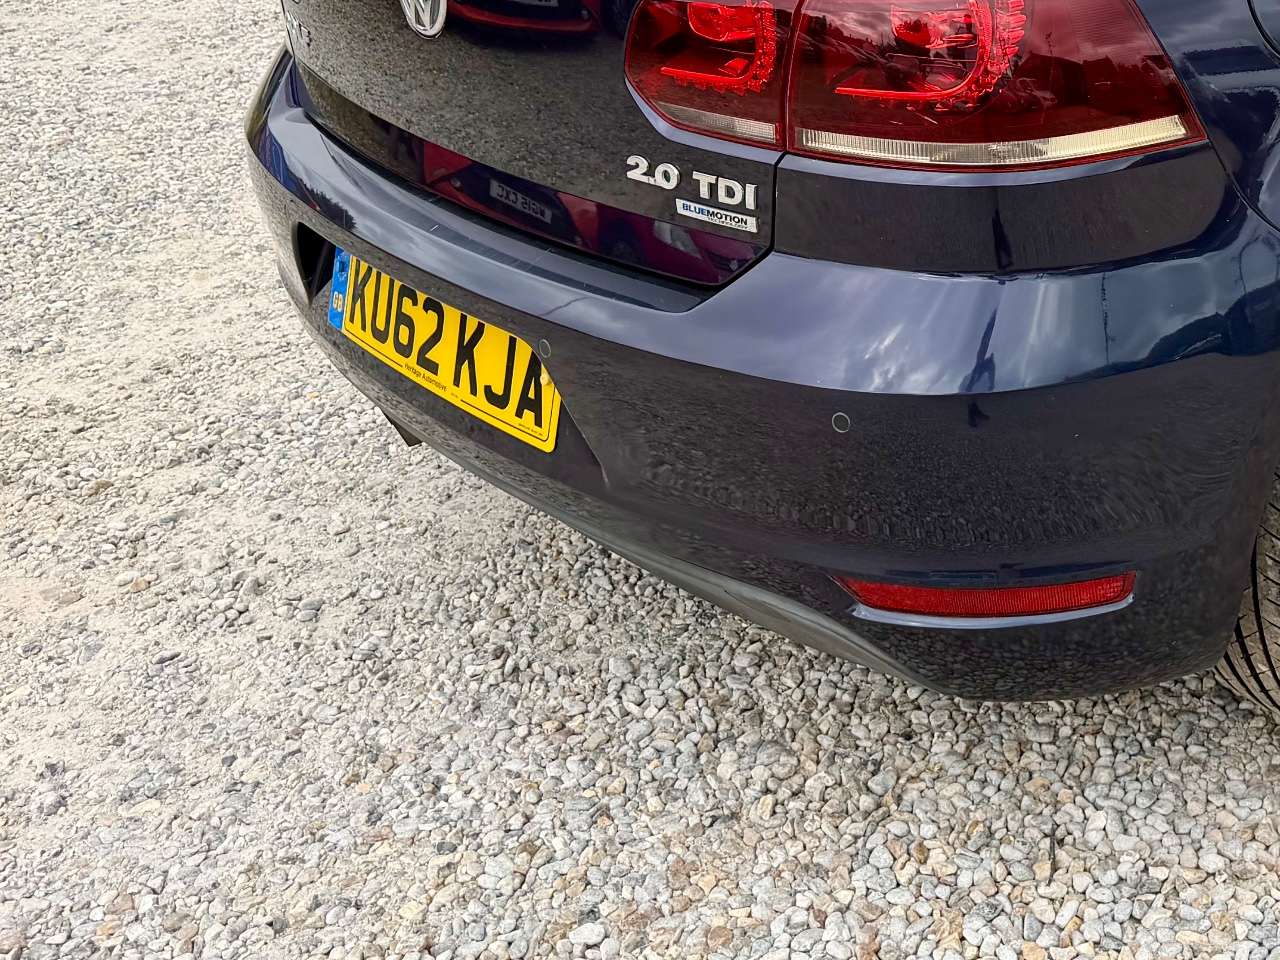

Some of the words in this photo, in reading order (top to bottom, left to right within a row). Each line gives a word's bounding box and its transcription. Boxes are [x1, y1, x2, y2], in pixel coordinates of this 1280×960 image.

[626, 154, 680, 190] 2.0
[692, 170, 757, 211] TDI
[682, 200, 748, 226] BLUEMOTION
[332, 291, 344, 313] GB
[349, 258, 445, 377] KU62
[453, 312, 543, 429] KJA
